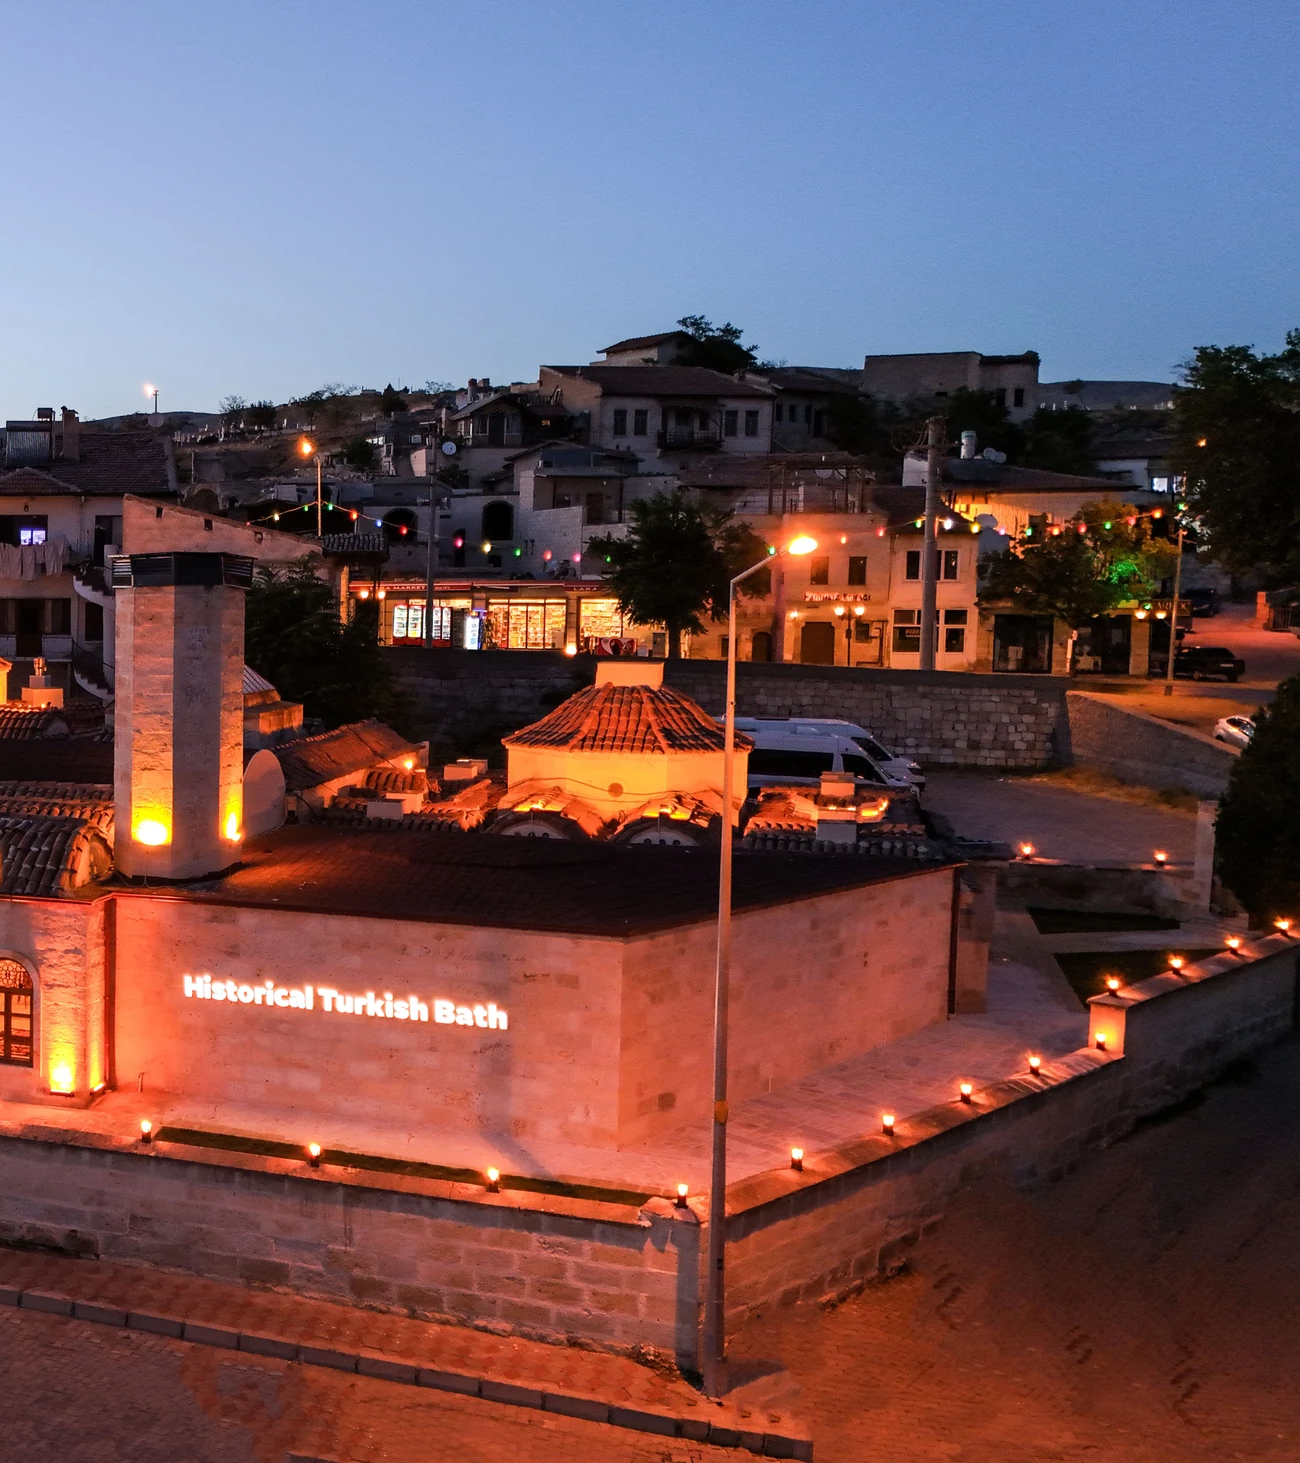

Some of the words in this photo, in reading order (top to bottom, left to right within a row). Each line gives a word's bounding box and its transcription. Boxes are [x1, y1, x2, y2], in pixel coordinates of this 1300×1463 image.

[184, 974, 314, 1010] Historical
[317, 988, 429, 1021] Turkish
[434, 1000, 508, 1030] Bath
